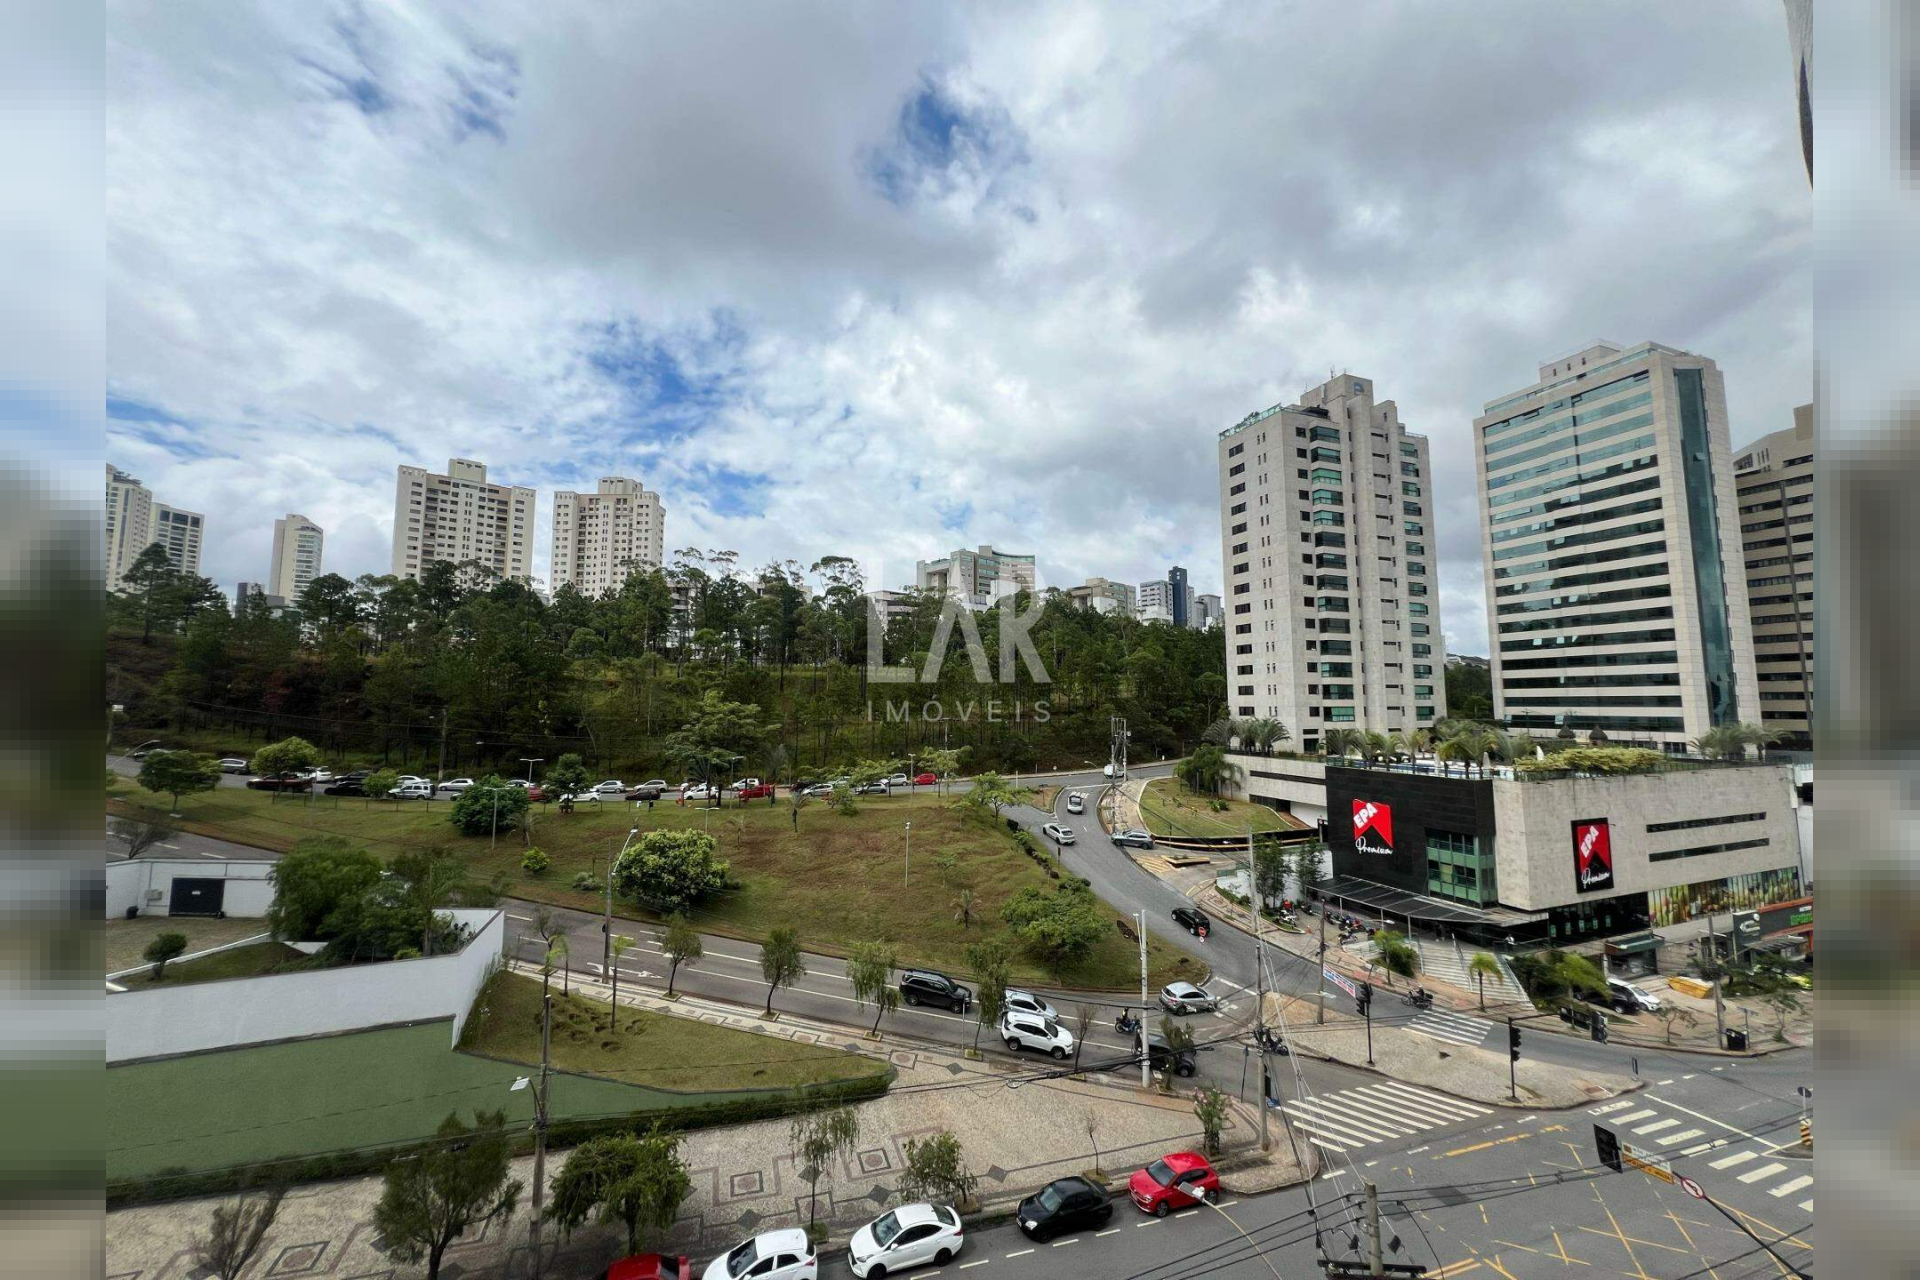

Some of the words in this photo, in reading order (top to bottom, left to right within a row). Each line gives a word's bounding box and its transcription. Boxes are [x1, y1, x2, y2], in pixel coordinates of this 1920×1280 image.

[1353, 802, 1378, 829] EPA
[1355, 835, 1393, 855] Premium
[1580, 825, 1599, 858] EPA
[1581, 867, 1610, 889] Premium
